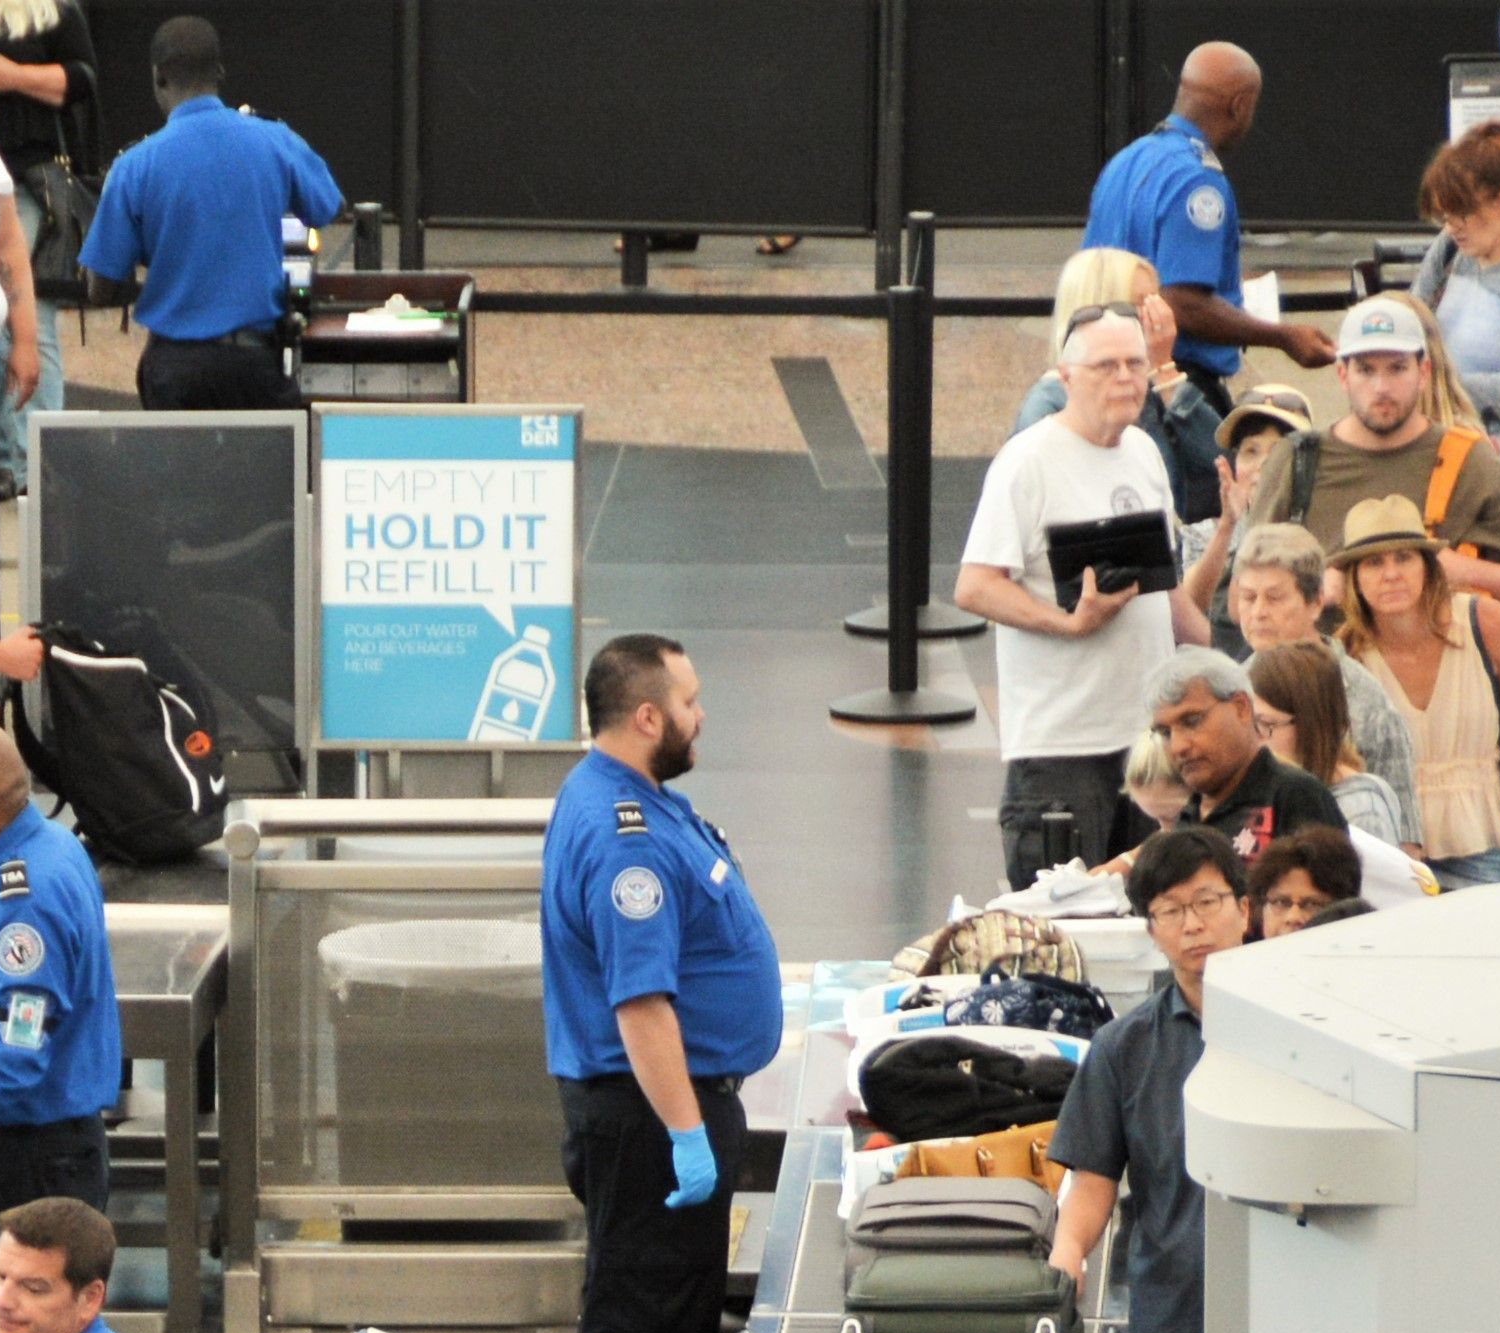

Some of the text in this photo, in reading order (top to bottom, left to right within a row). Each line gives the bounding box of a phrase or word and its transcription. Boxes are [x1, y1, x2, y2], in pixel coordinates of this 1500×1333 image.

[522, 430, 558, 447] DEN
[344, 469, 547, 503] EMPTY IT
[344, 513, 547, 550] HOLD IT
[344, 560, 547, 593] REFILL IT
[343, 623, 478, 638] POUR OUT WATER
[343, 641, 467, 655] AND BEVERAGES
[343, 658, 383, 673] HERE
[617, 811, 643, 822] TSA
[0, 871, 26, 885] TSA
